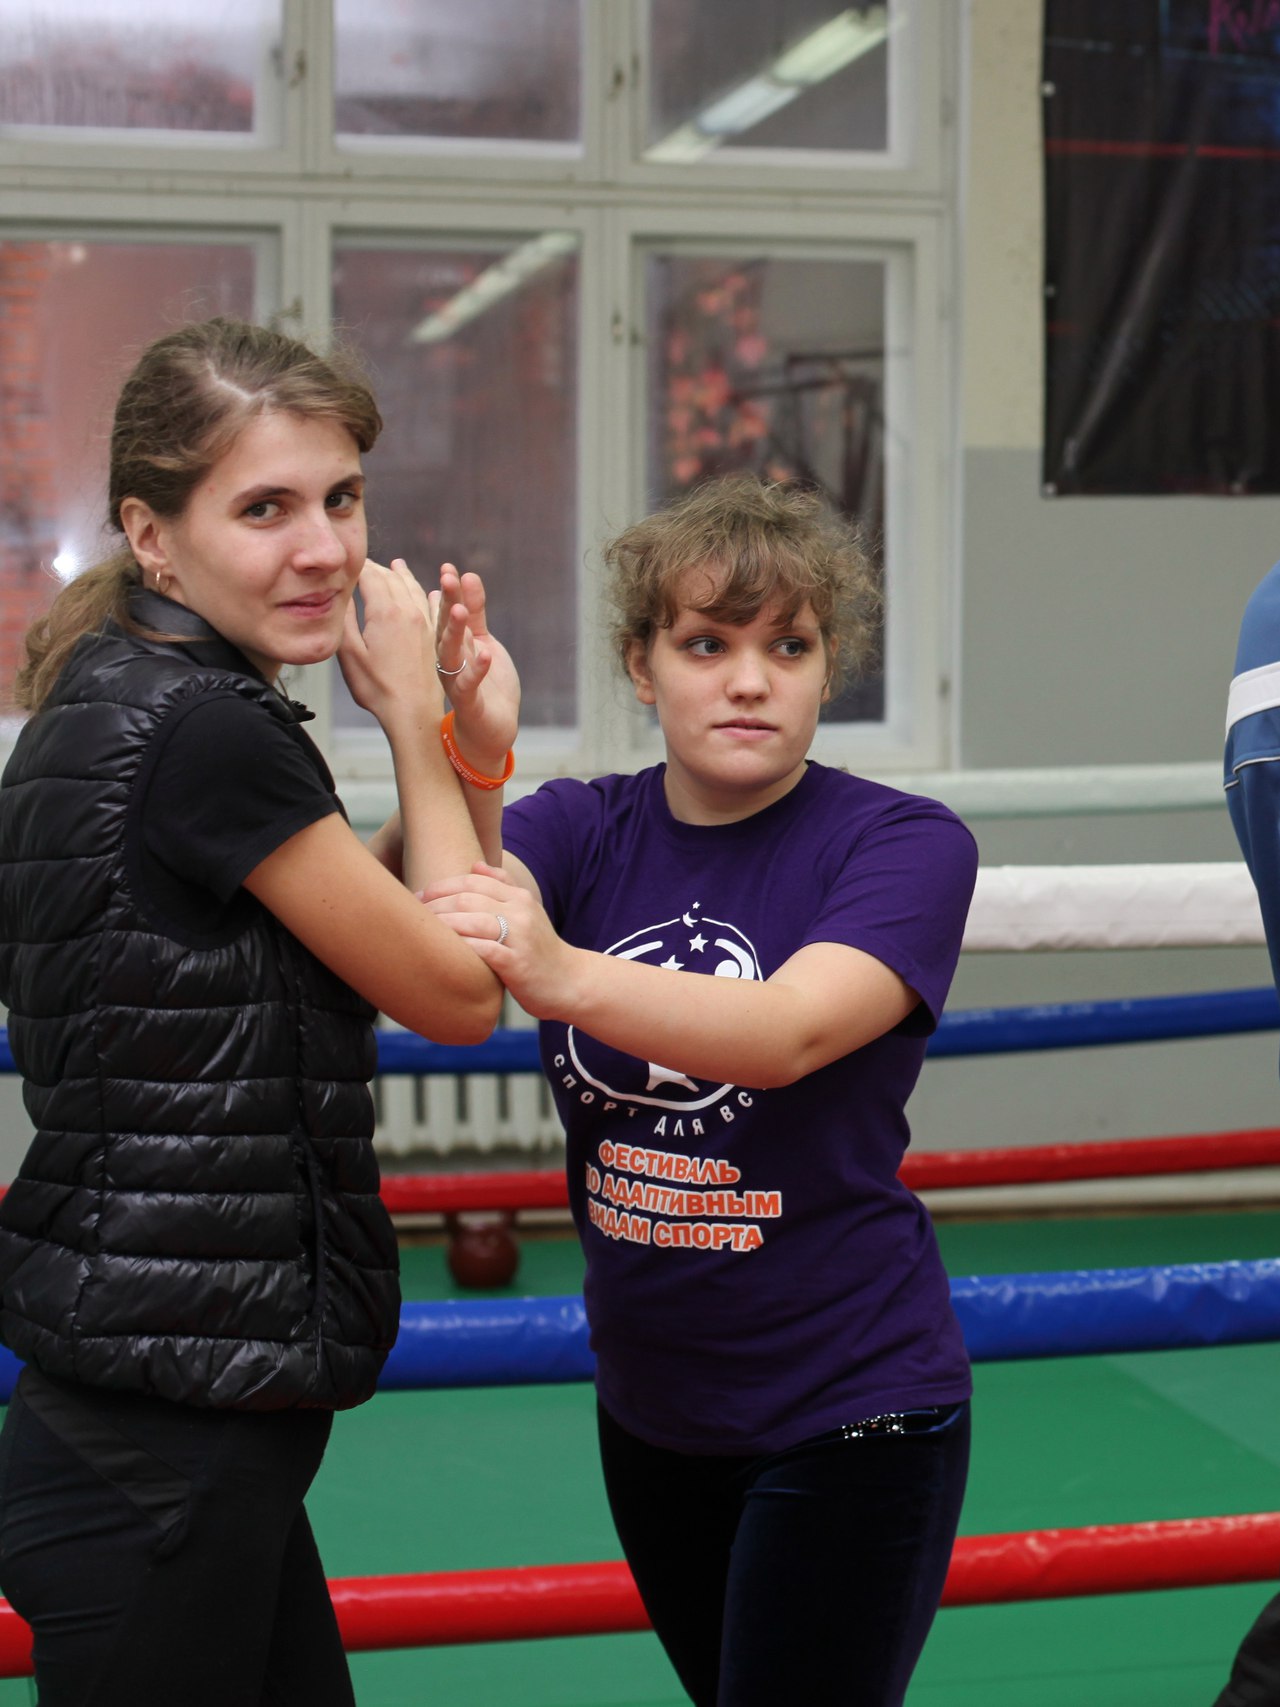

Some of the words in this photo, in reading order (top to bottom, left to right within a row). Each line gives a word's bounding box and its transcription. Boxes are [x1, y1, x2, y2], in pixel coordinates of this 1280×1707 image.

[553, 1053, 639, 1118] СПОРТ
[653, 1115, 705, 1137] ДЛЯ
[719, 1091, 754, 1123] ВС
[598, 1140, 741, 1185] ФЕСТИВАЛЬ
[602, 1173, 782, 1218] АДАПТИВНЫМ
[588, 1197, 651, 1245] ВИДАМ
[653, 1220, 764, 1252] СПОРТА
